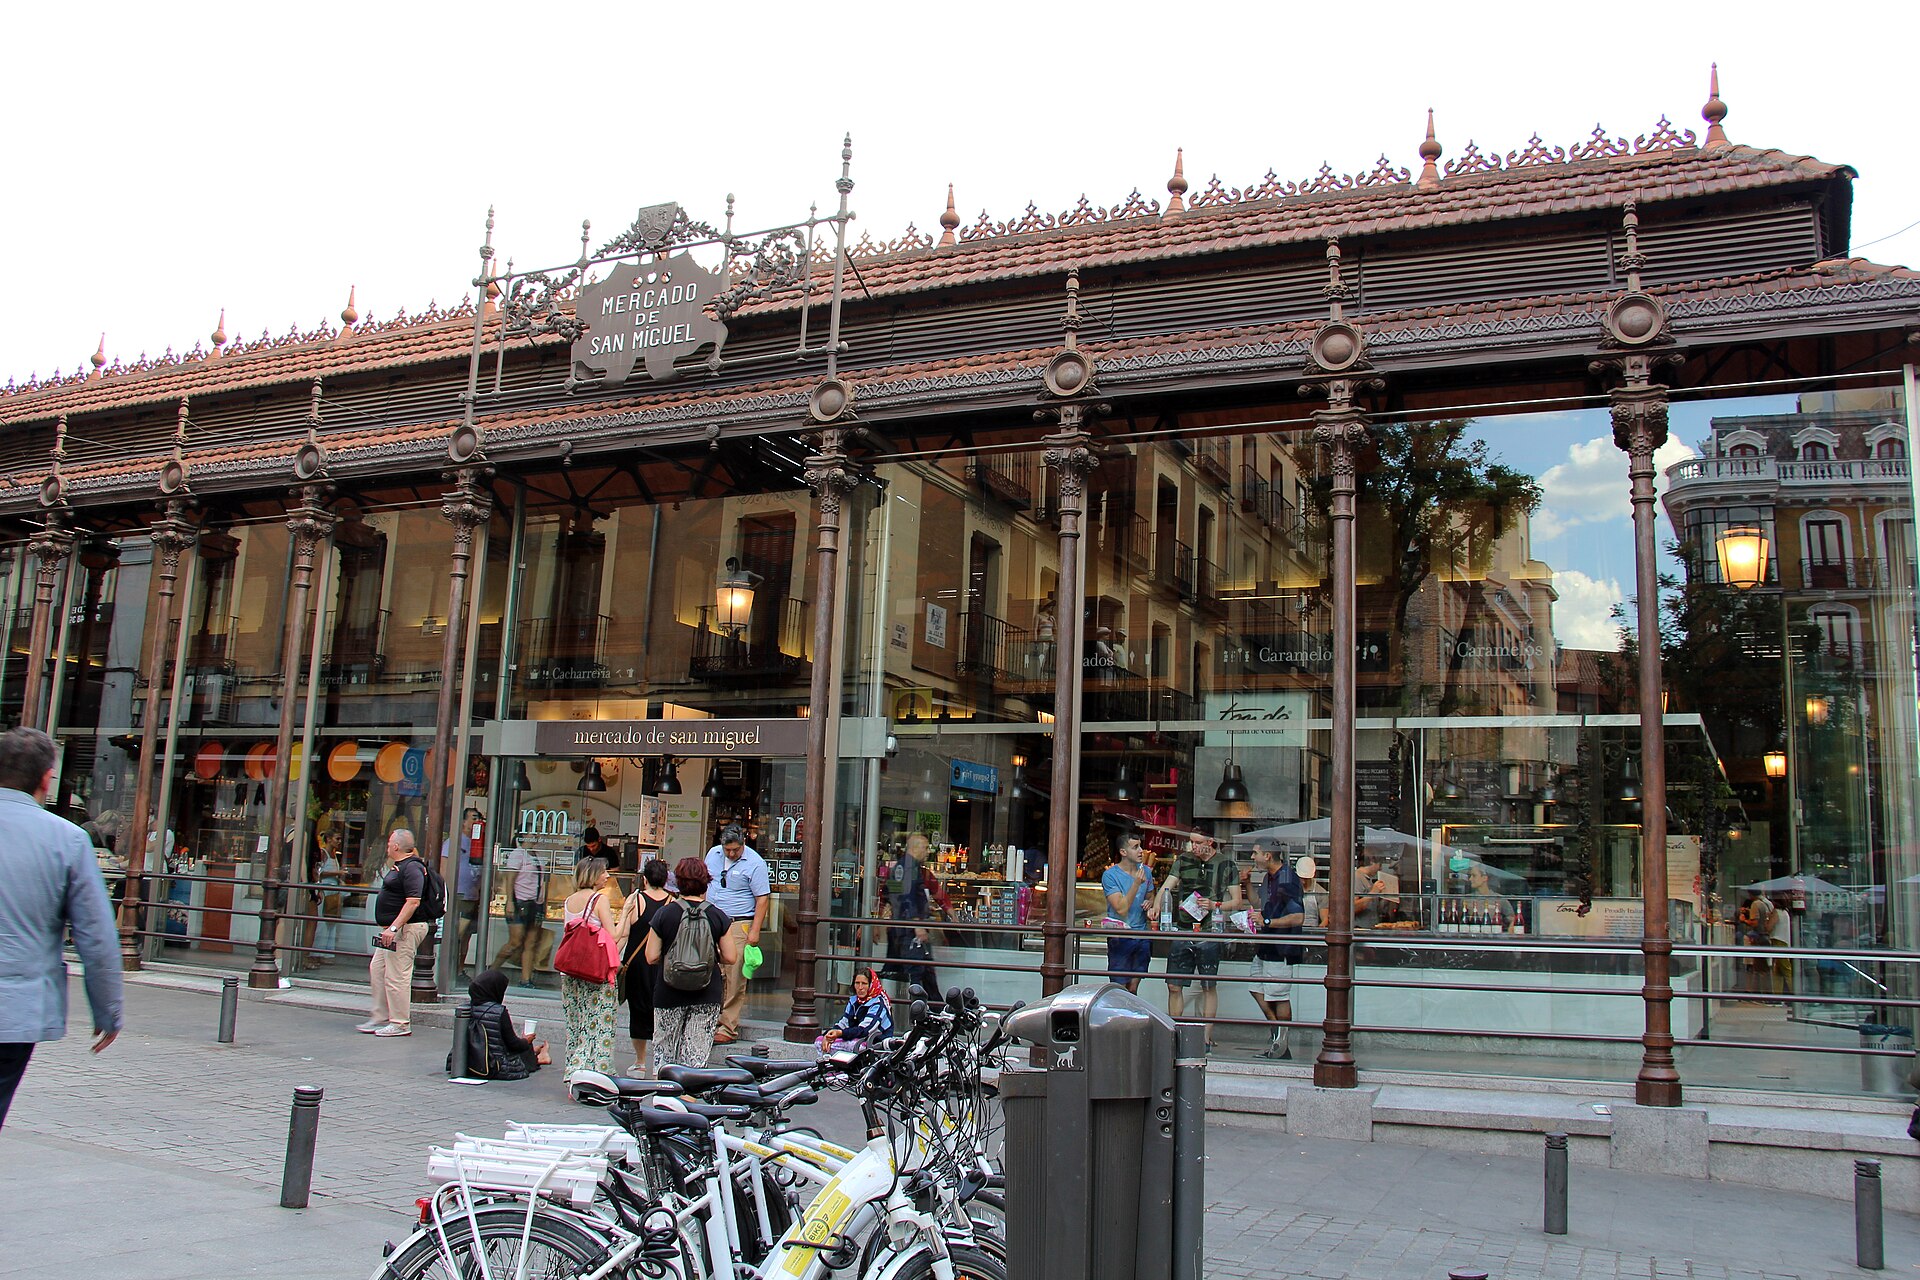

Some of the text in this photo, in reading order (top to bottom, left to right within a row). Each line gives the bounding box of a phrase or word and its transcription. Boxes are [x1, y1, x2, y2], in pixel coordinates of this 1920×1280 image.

[602, 283, 697, 315] MERCADO
[634, 310, 660, 327] DE
[589, 333, 625, 356] SAN
[1258, 646, 1334, 663] Caramelo
[1456, 641, 1543, 658] Caramelos
[1083, 652, 1115, 667] ados
[573, 725, 761, 751] mercado de san miguel
[774, 846, 797, 854] mercado
[808, 1223, 824, 1241] BIKE
